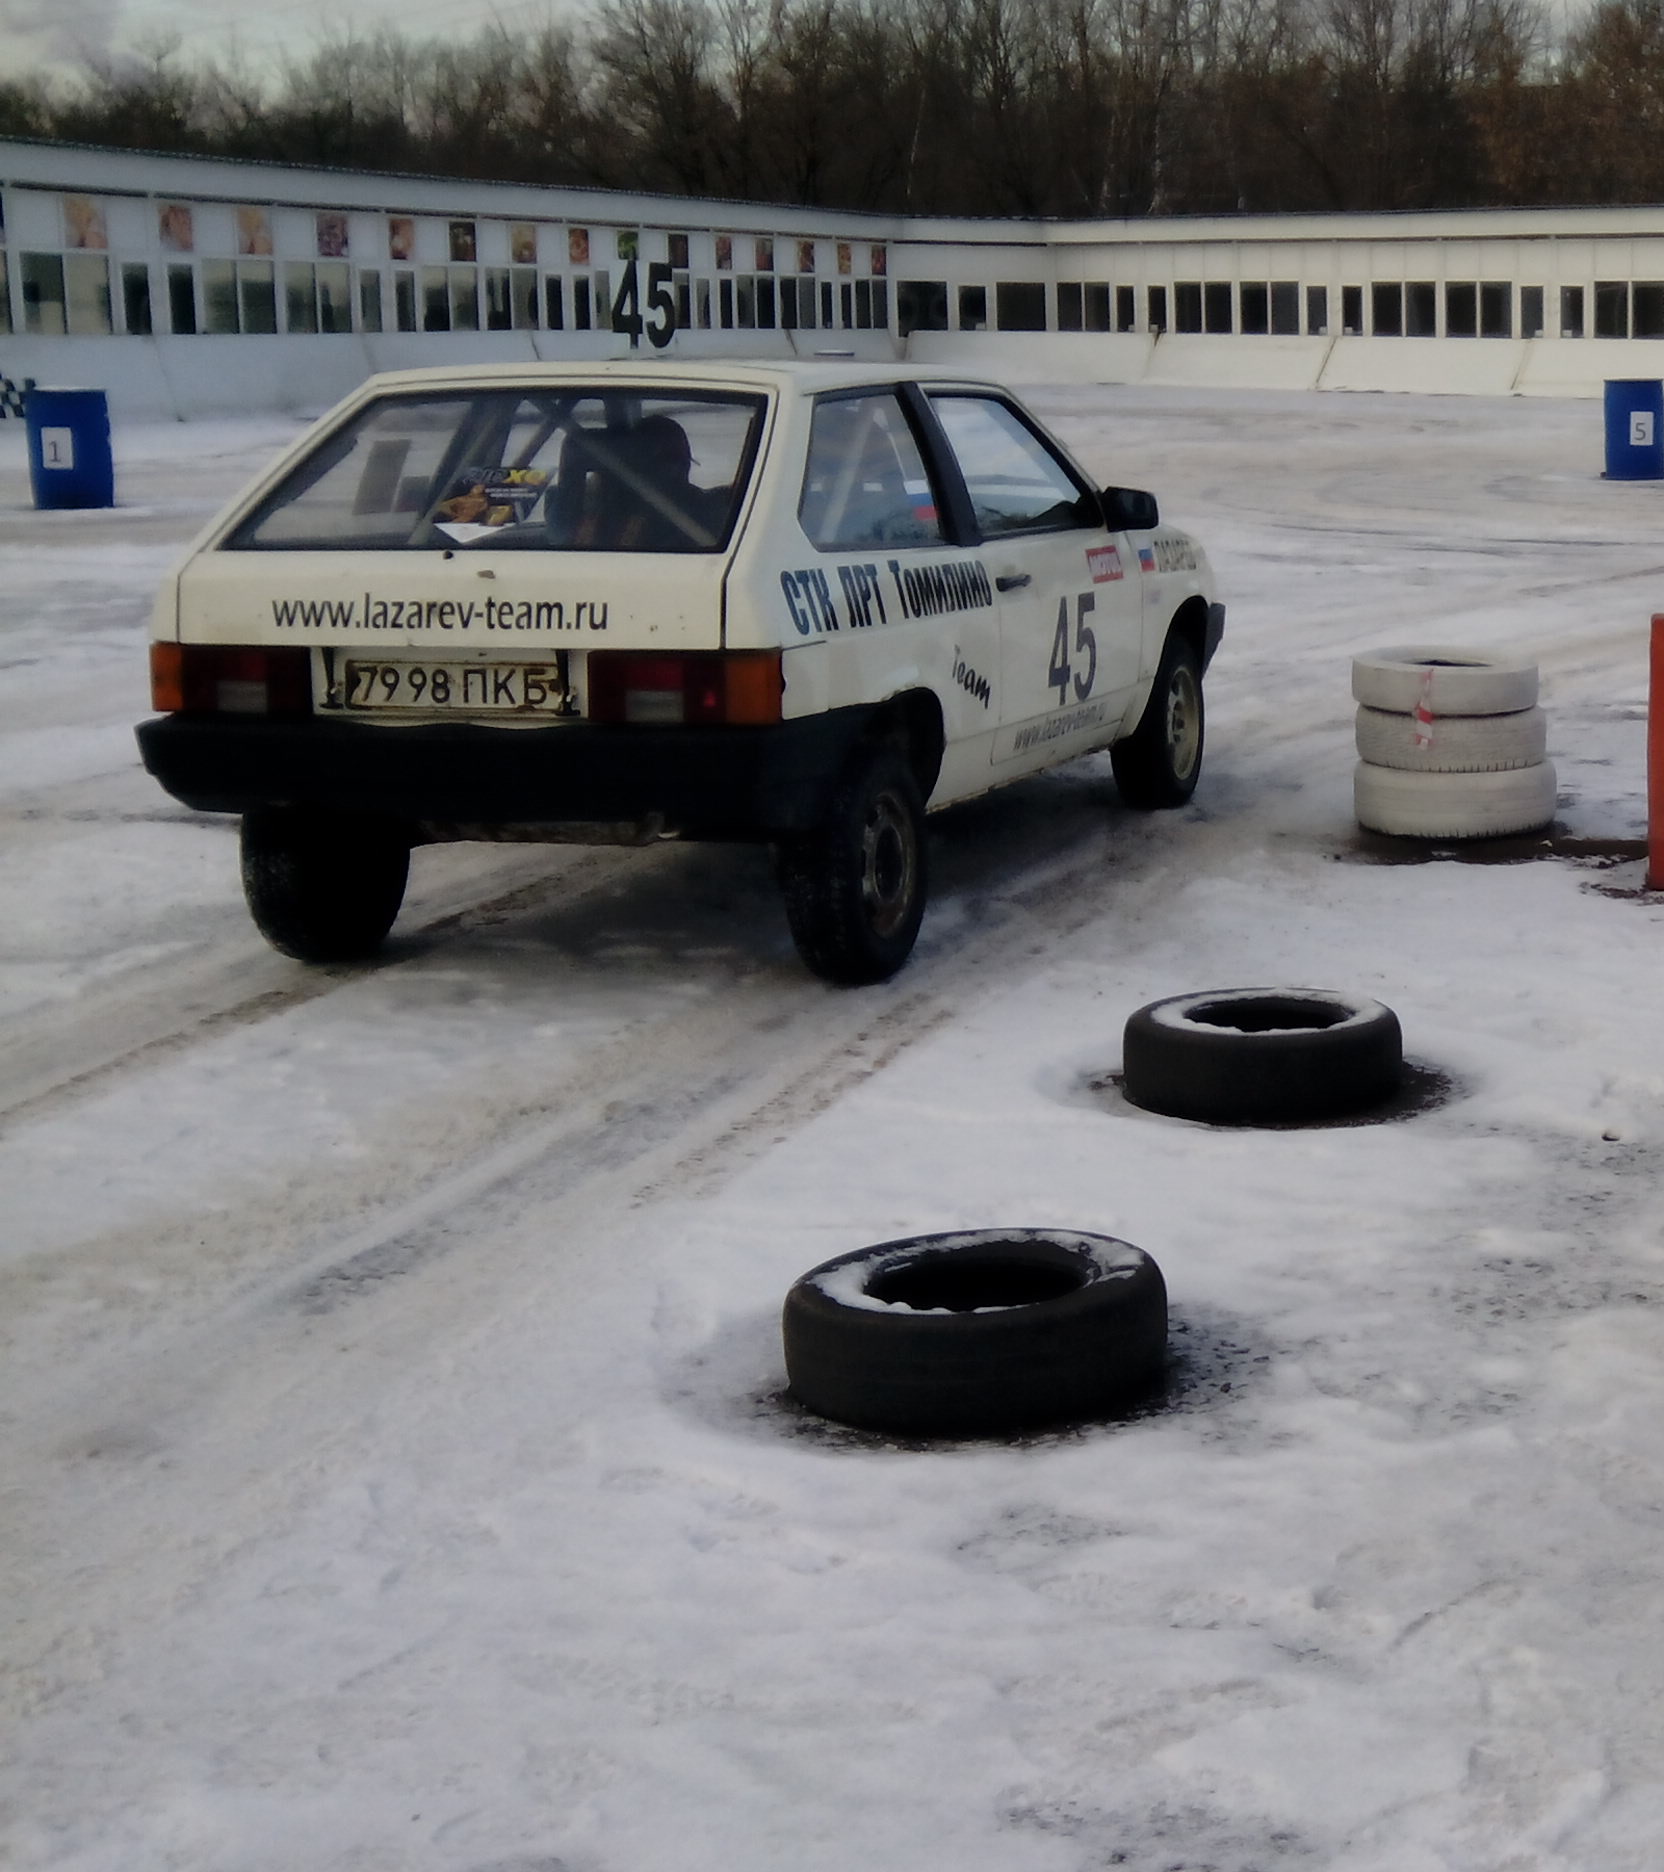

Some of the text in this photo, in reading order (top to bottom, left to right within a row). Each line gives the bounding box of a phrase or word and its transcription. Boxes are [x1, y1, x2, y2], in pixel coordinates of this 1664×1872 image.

[612, 247, 675, 350] 45
[48, 440, 60, 462] 1
[1634, 422, 1646, 441] 5
[272, 592, 608, 631] www.lazarev-team.ru
[780, 568, 839, 635] СТК
[1048, 592, 1096, 706] 45
